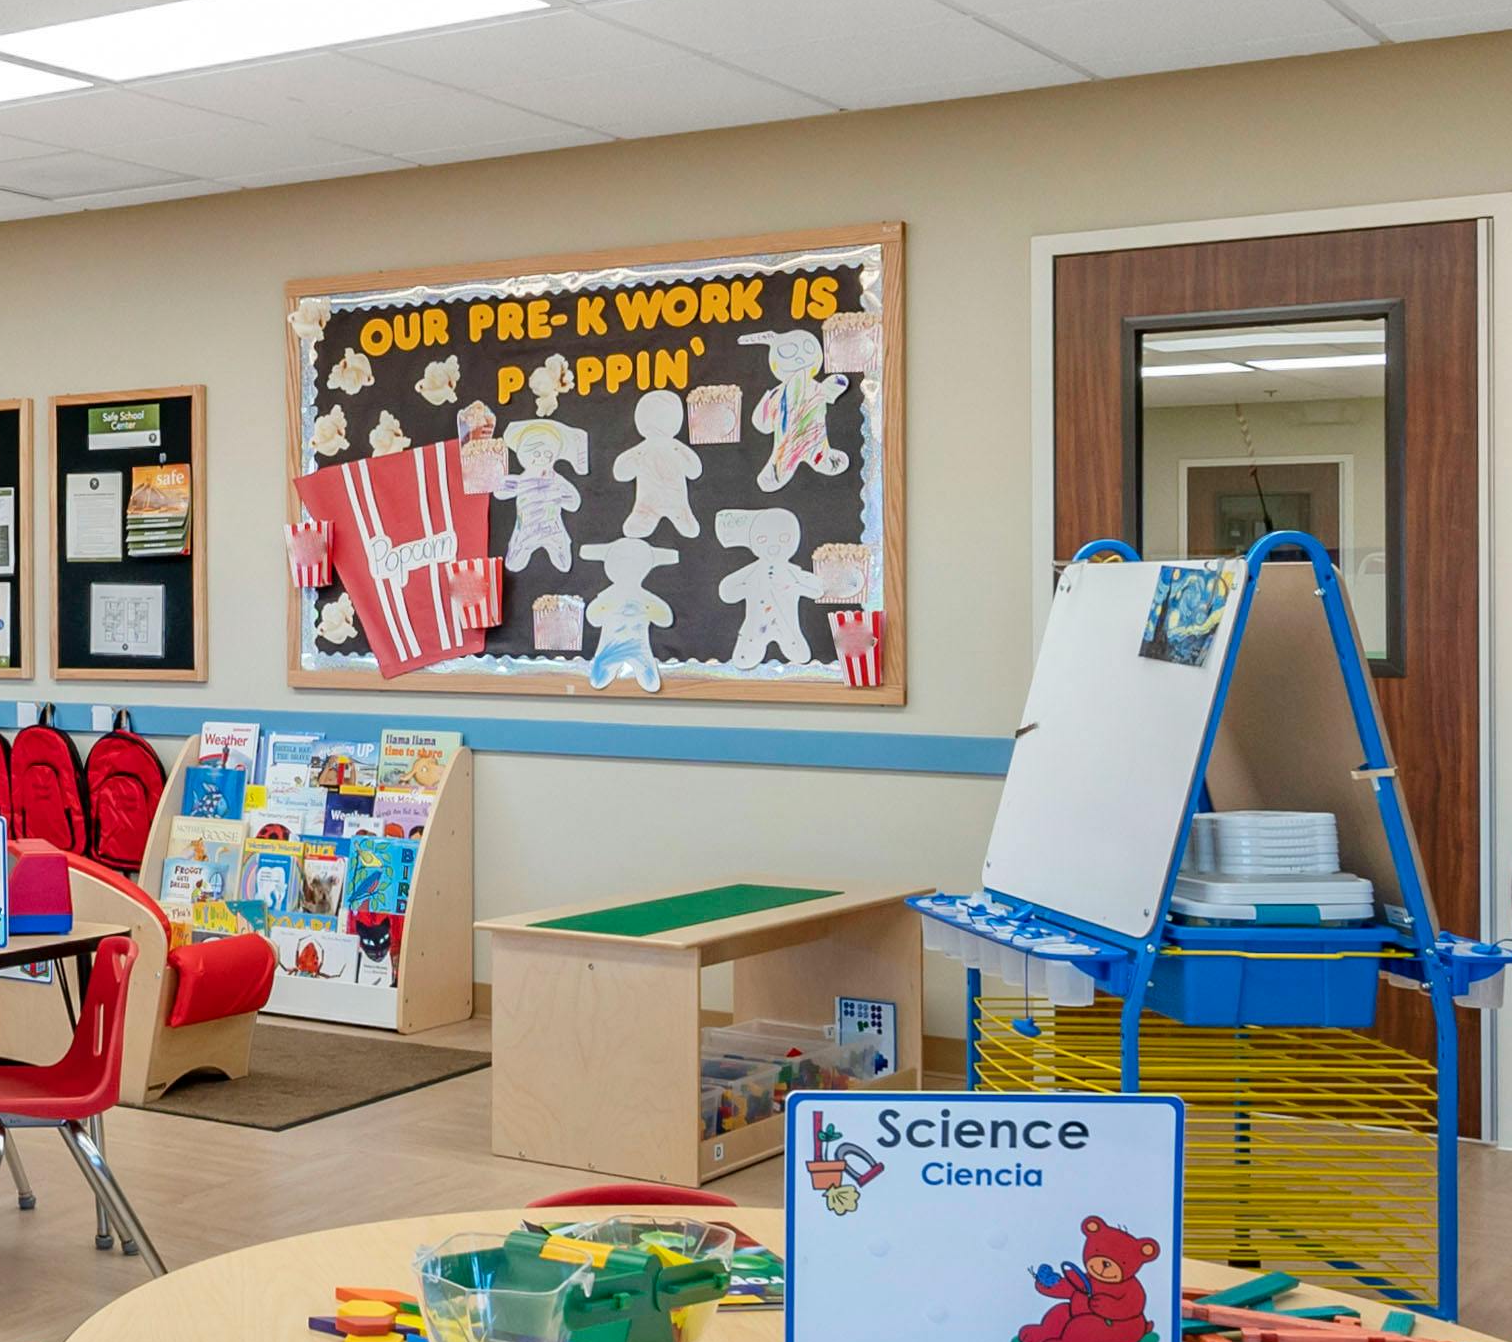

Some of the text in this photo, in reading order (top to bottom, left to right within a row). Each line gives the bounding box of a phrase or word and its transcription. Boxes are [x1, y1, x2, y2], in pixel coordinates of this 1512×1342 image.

[360, 308, 449, 357] OUR
[615, 278, 764, 332] WORK
[790, 276, 839, 321] IS
[102, 410, 145, 423] Safe School
[110, 421, 136, 430] Center
[156, 469, 185, 486] safe
[372, 536, 453, 585] Popcorn
[205, 733, 249, 747] Weather
[357, 743, 375, 757] UP
[174, 865, 203, 875] FROGGY
[877, 1107, 1090, 1151] Science
[920, 1161, 1044, 1187] Ciencia
